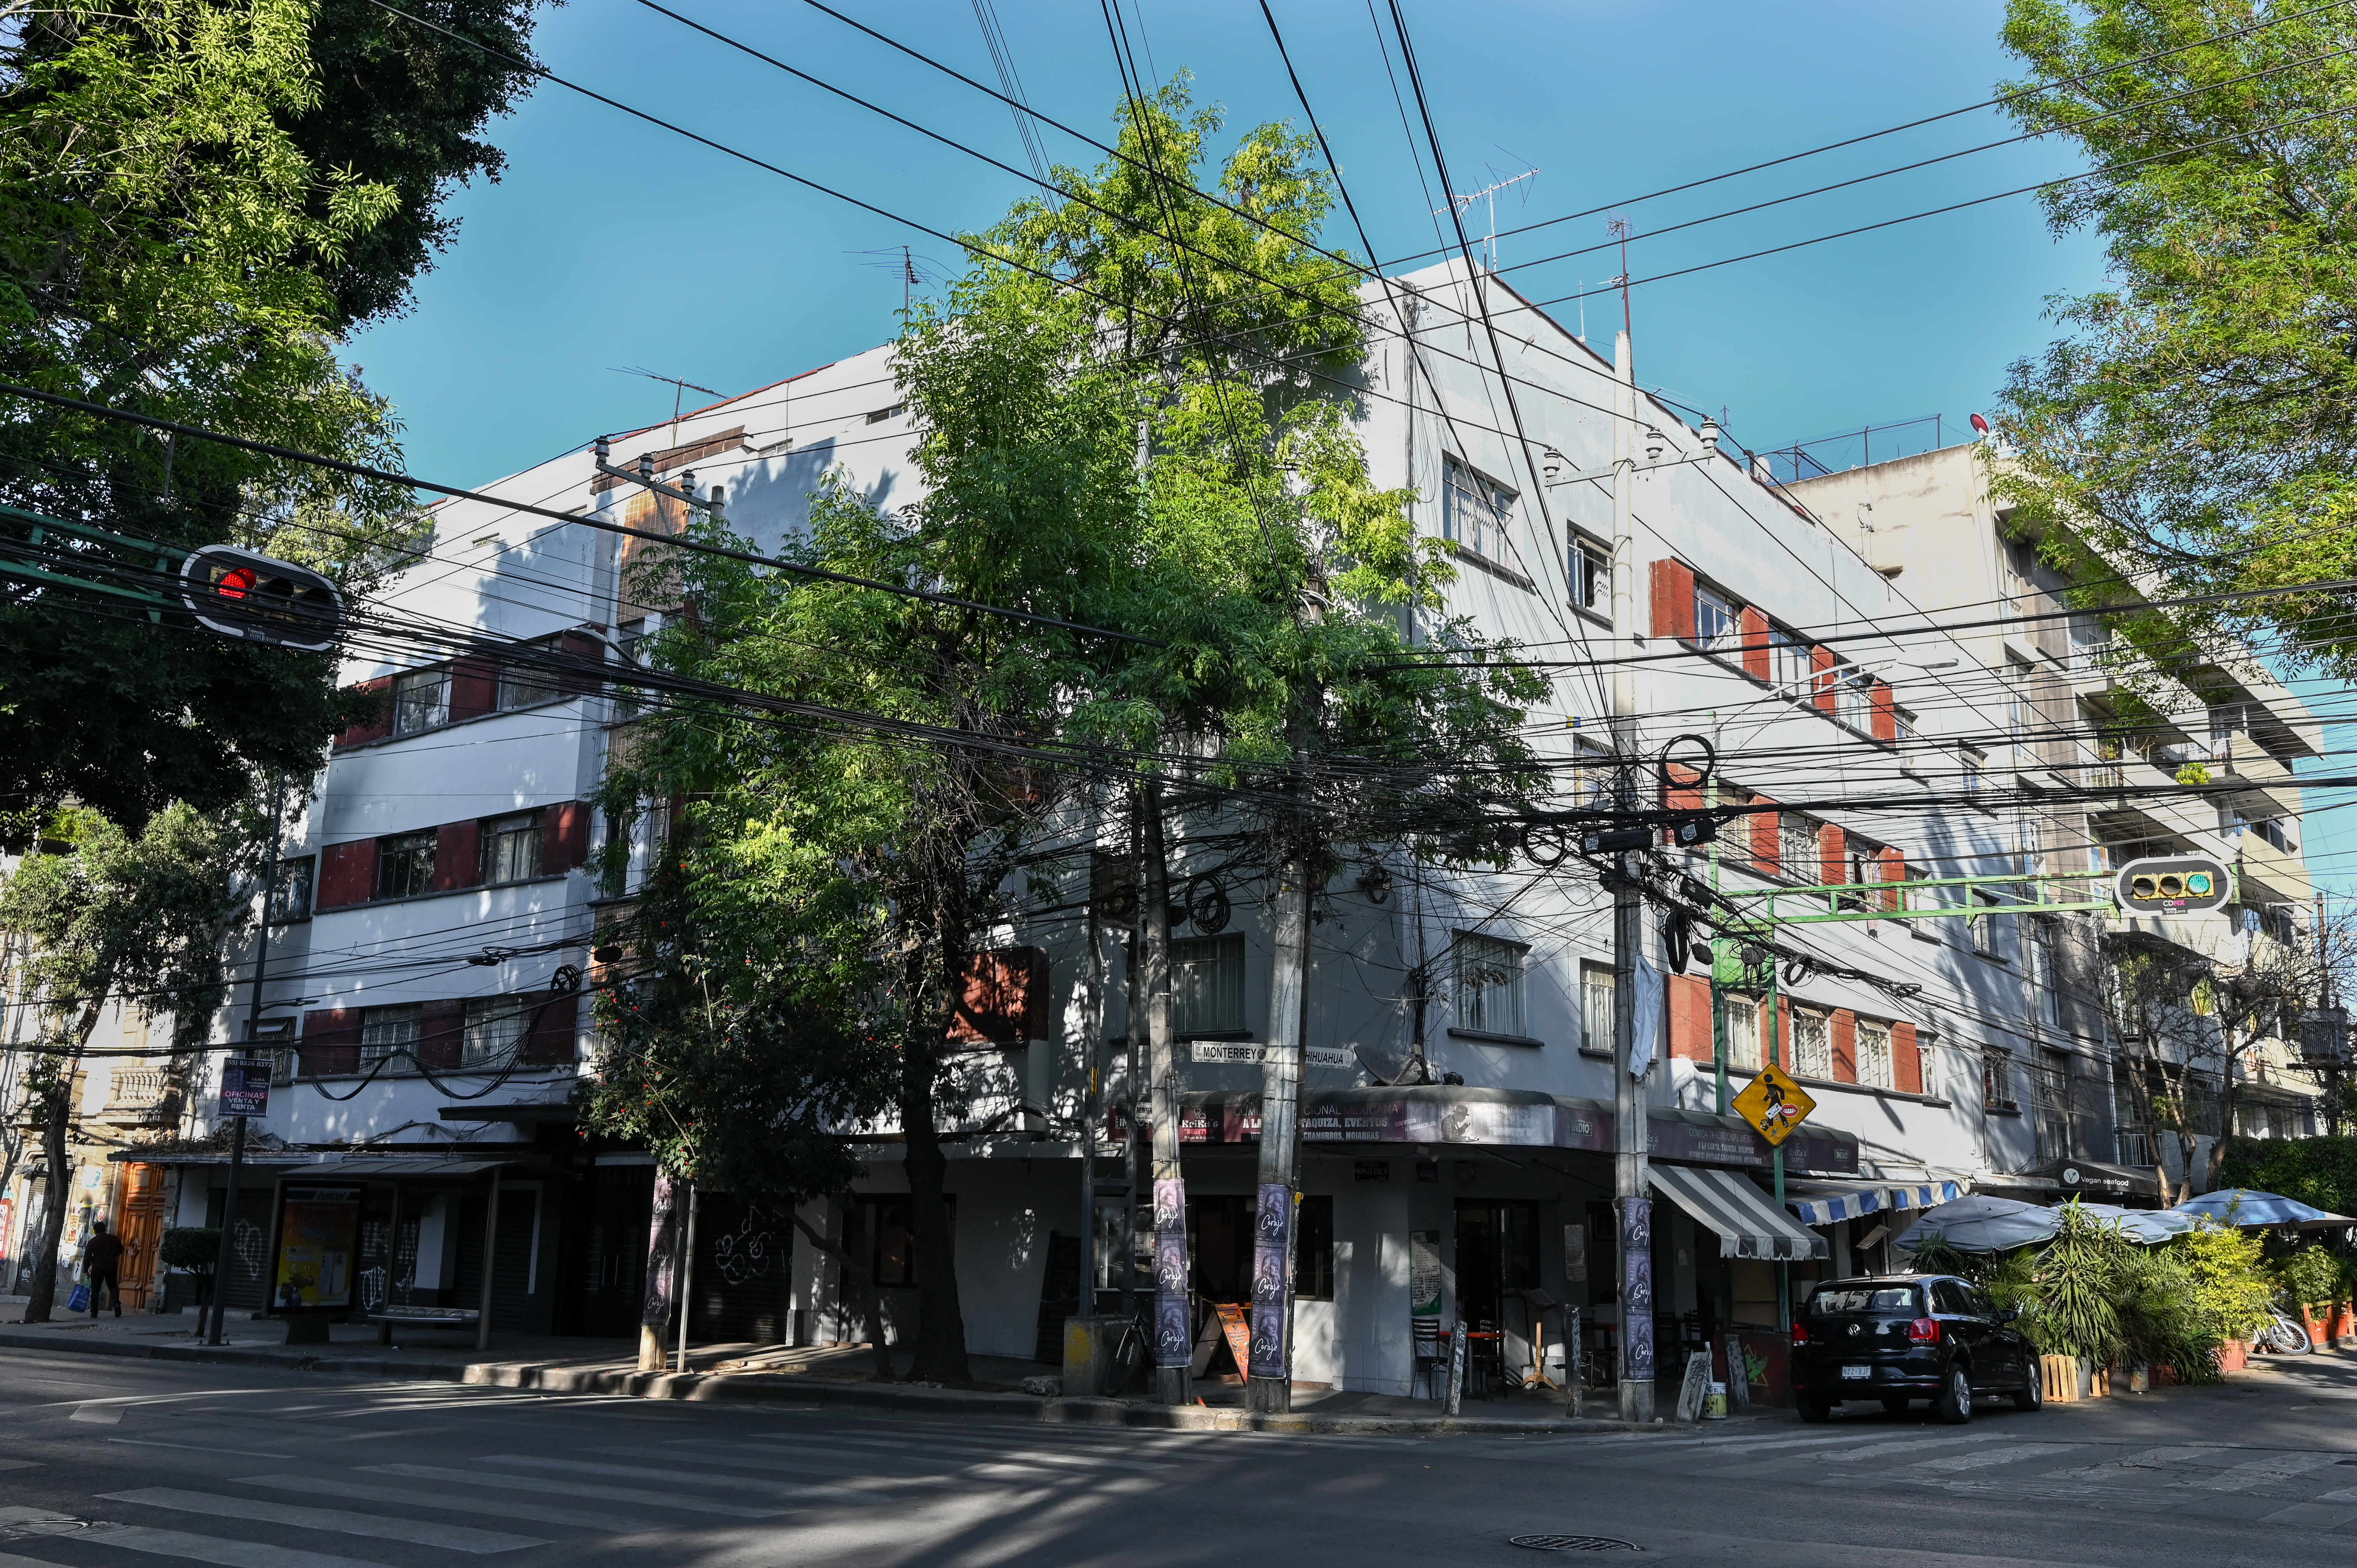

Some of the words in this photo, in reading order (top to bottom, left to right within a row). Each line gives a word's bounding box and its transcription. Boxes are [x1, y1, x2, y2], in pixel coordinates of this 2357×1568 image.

[1204, 1047, 1256, 1059] MONTERREY
[1305, 1051, 1343, 1064] HIHUAHUA
[225, 1091, 264, 1099] OFICINAS
[1304, 1105, 1341, 1115] CIONAL
[1344, 1104, 1398, 1114] MEXICANA
[1120, 1118, 1145, 1127] INO
[1243, 1118, 1249, 1128] A
[1251, 1118, 1262, 1128] LA
[1302, 1117, 1342, 1128] TAQUIZA,
[1345, 1117, 1388, 1127] EVENTOS
[1394, 1118, 1416, 1127] SERVICIO
[1409, 1121, 1436, 1131] DOMICILIO
[1571, 1123, 1590, 1134] INDIO
[1302, 1132, 1344, 1141] ,CHAMORROS,
[1346, 1131, 1379, 1140] MOJARRAS
[1689, 1128, 1708, 1138] COMIDA
[1709, 1130, 1739, 1142] TRADICIONAL
[1740, 1135, 1755, 1143] MEXIC
[1836, 1151, 1848, 1160] INDIO
[317, 1191, 346, 1200] telcel
[1157, 1208, 1178, 1229] Coraje
[1261, 1214, 1283, 1236] Coraje
[652, 1250, 669, 1266] Coraje
[1159, 1268, 1182, 1289] Coraje
[1258, 1278, 1280, 1300] Coraje
[648, 1297, 664, 1314] Coraje
[1161, 1330, 1184, 1351] Coraje
[1254, 1338, 1277, 1361] Coraje
